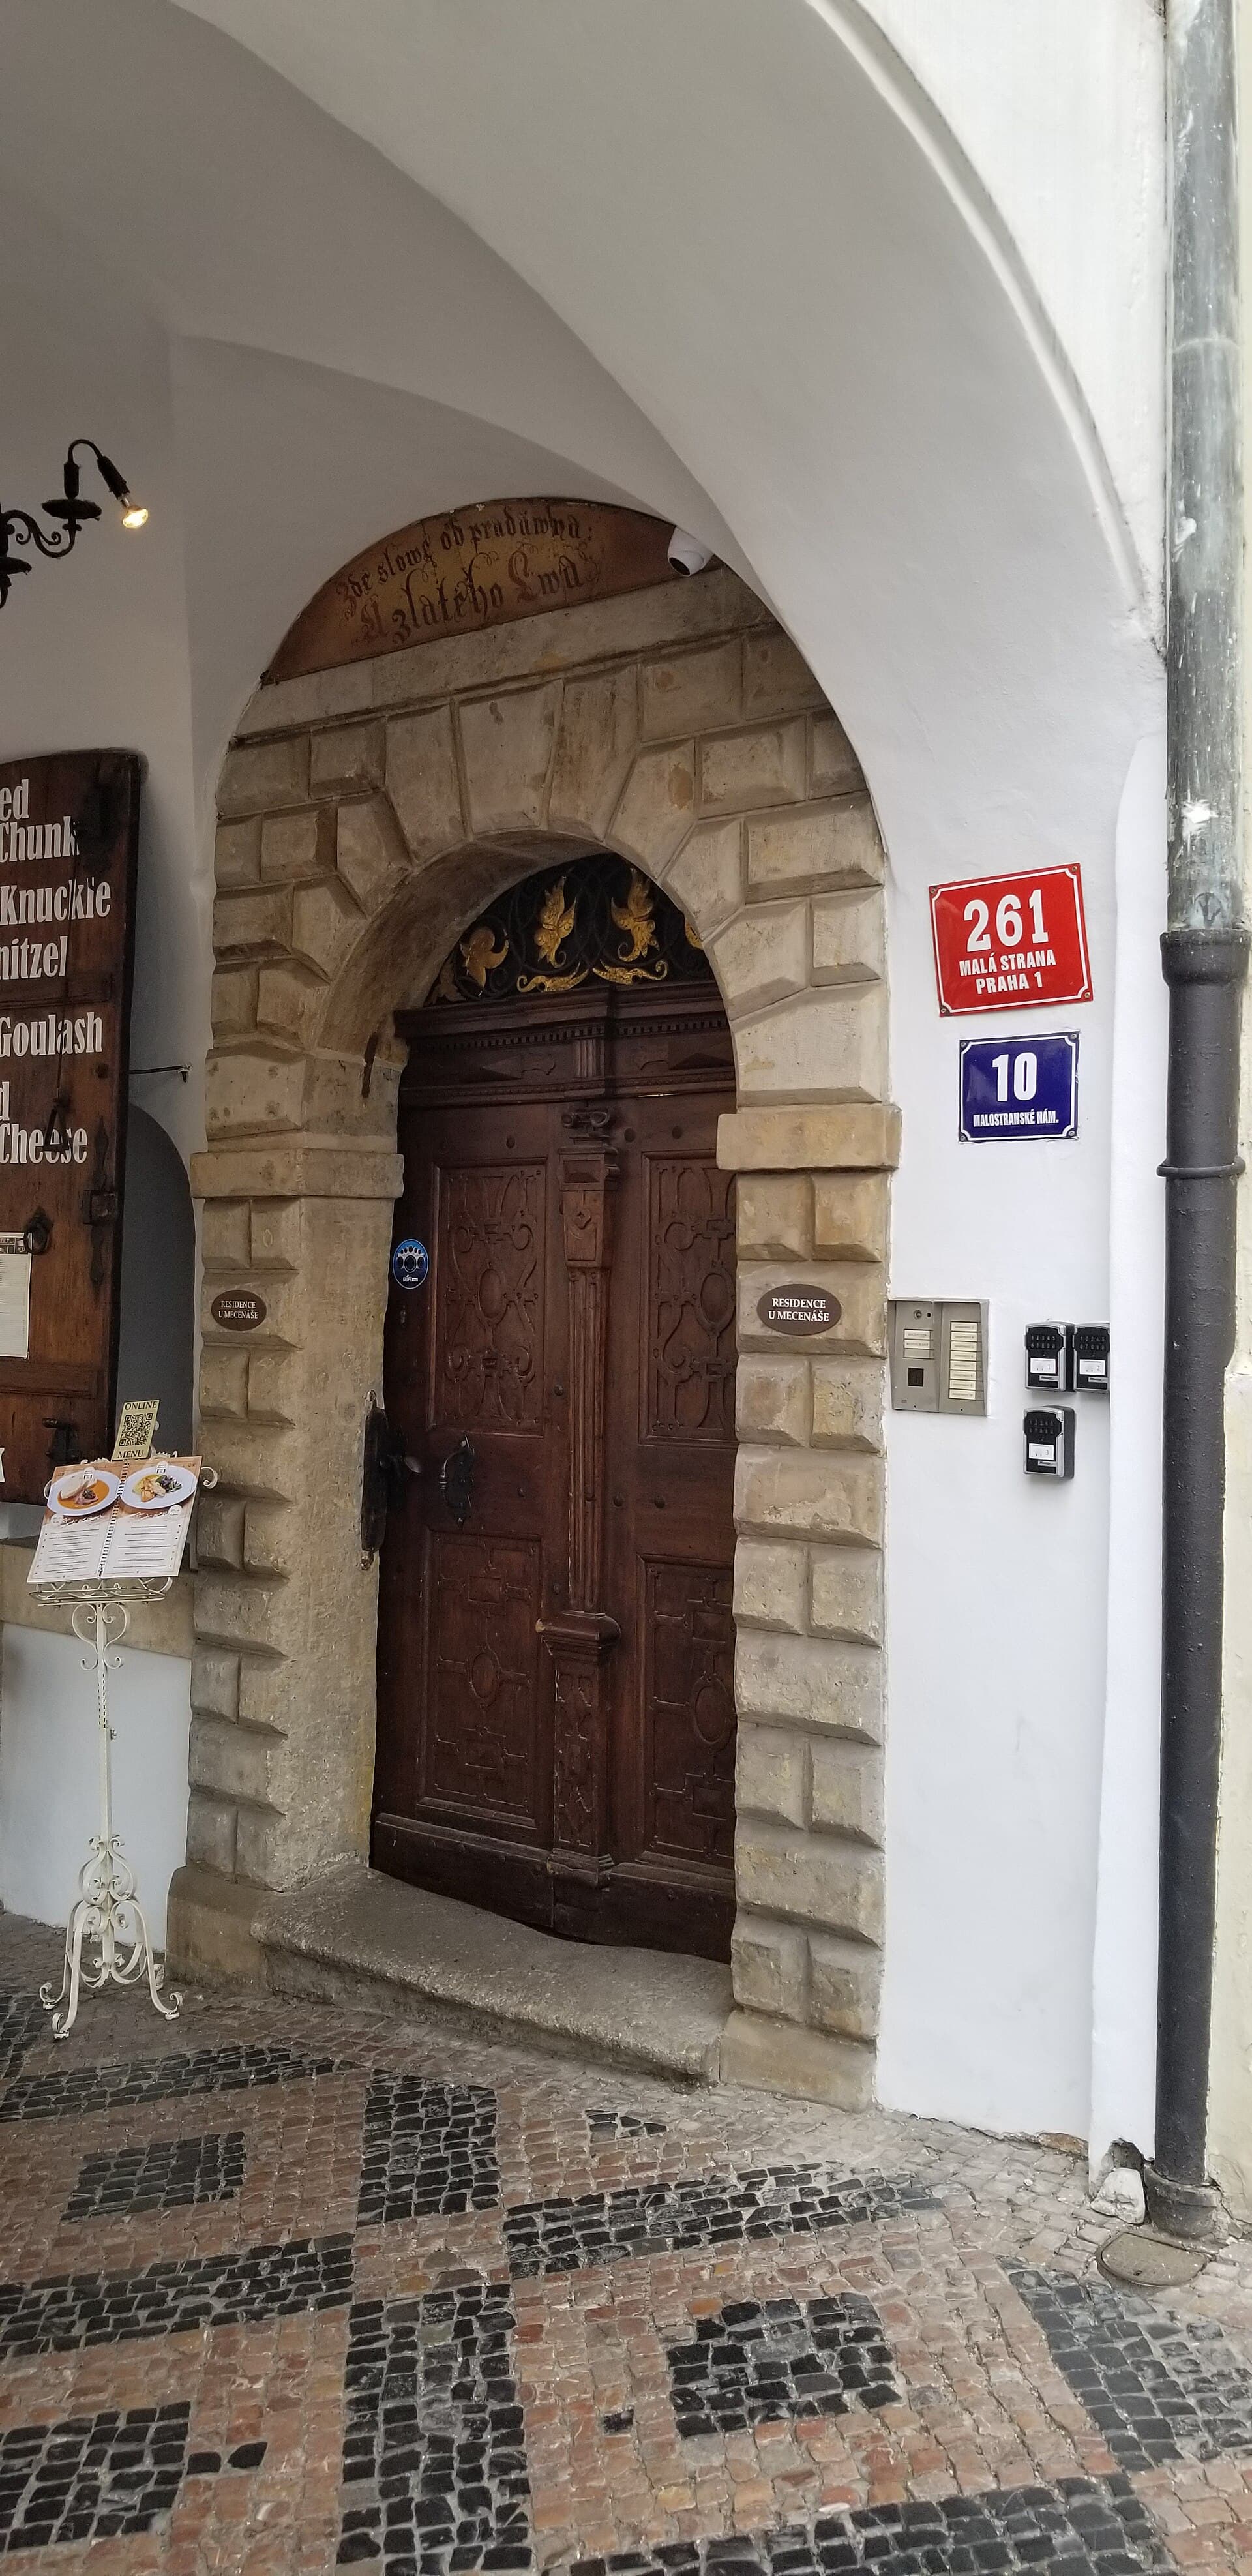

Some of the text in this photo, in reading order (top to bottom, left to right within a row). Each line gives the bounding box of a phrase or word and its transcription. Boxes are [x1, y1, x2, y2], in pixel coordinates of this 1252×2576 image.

[0, 779, 29, 821] ed
[964, 889, 1049, 953] 261
[959, 950, 1056, 976] MALÁ STRANA
[976, 971, 1043, 995] PRAHA 1
[0, 1012, 102, 1057] Goulash
[992, 1052, 1037, 1101] 10
[974, 1108, 1059, 1127] MALOSTRANSKÉ NÁM.
[771, 1298, 826, 1308] RESIDENCE
[224, 1310, 258, 1319] MECENÁŠE
[768, 1310, 829, 1322] U MECENÁŠE
[125, 1401, 158, 1410] ONLINE
[118, 1450, 144, 1458] MENU
